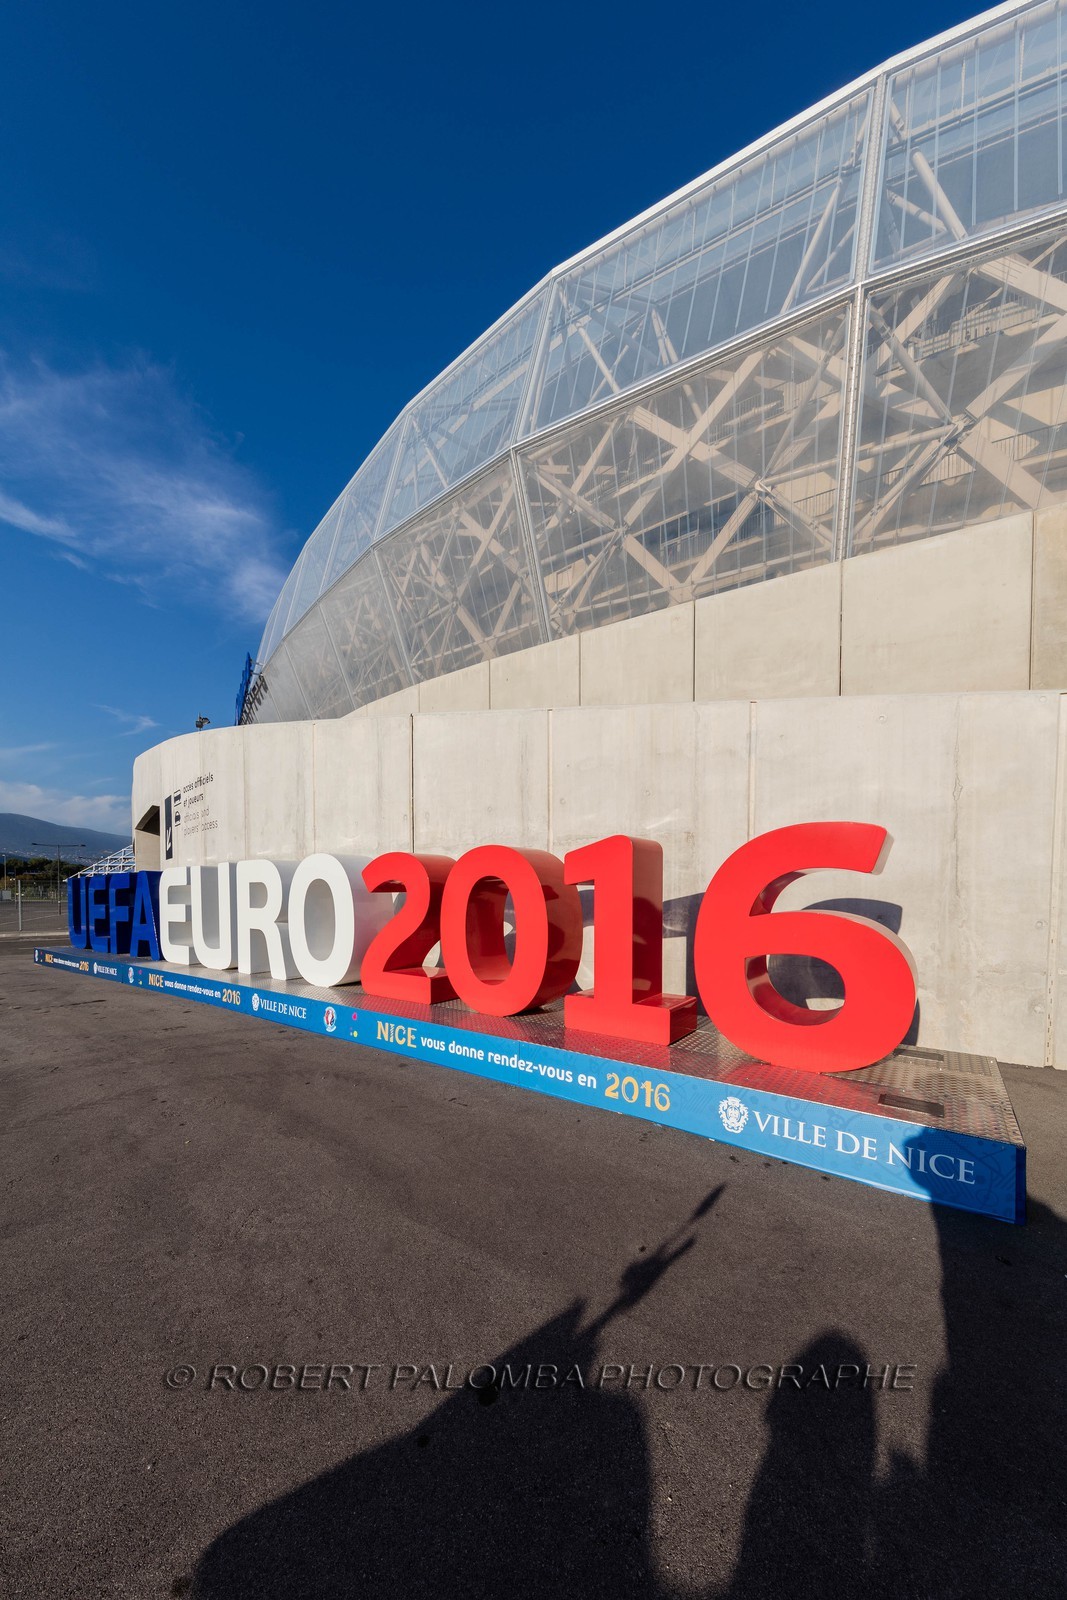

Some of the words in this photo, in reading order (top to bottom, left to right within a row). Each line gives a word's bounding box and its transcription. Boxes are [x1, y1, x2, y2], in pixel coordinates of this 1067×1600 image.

[67, 870, 160, 961] UEFA
[159, 853, 355, 988] EURO
[361, 821, 916, 1073] 2016
[149, 974, 164, 988] NICE
[164, 980, 174, 988] vous
[174, 981, 186, 990] donne
[187, 984, 214, 996] rendez-vous
[222, 989, 240, 1005] 2016
[260, 999, 278, 1012] VILLE
[278, 1003, 287, 1014] DE
[288, 1005, 307, 1019] NICE
[376, 1020, 417, 1049] NICE
[420, 1036, 445, 1052] vous
[449, 1040, 484, 1060] donne
[488, 1052, 573, 1083] rendez-vous
[577, 1072, 597, 1089] en
[604, 1072, 671, 1112] 2016
[752, 1110, 827, 1149] VILLE
[834, 1129, 878, 1161] DE
[886, 1142, 976, 1186] NICE
